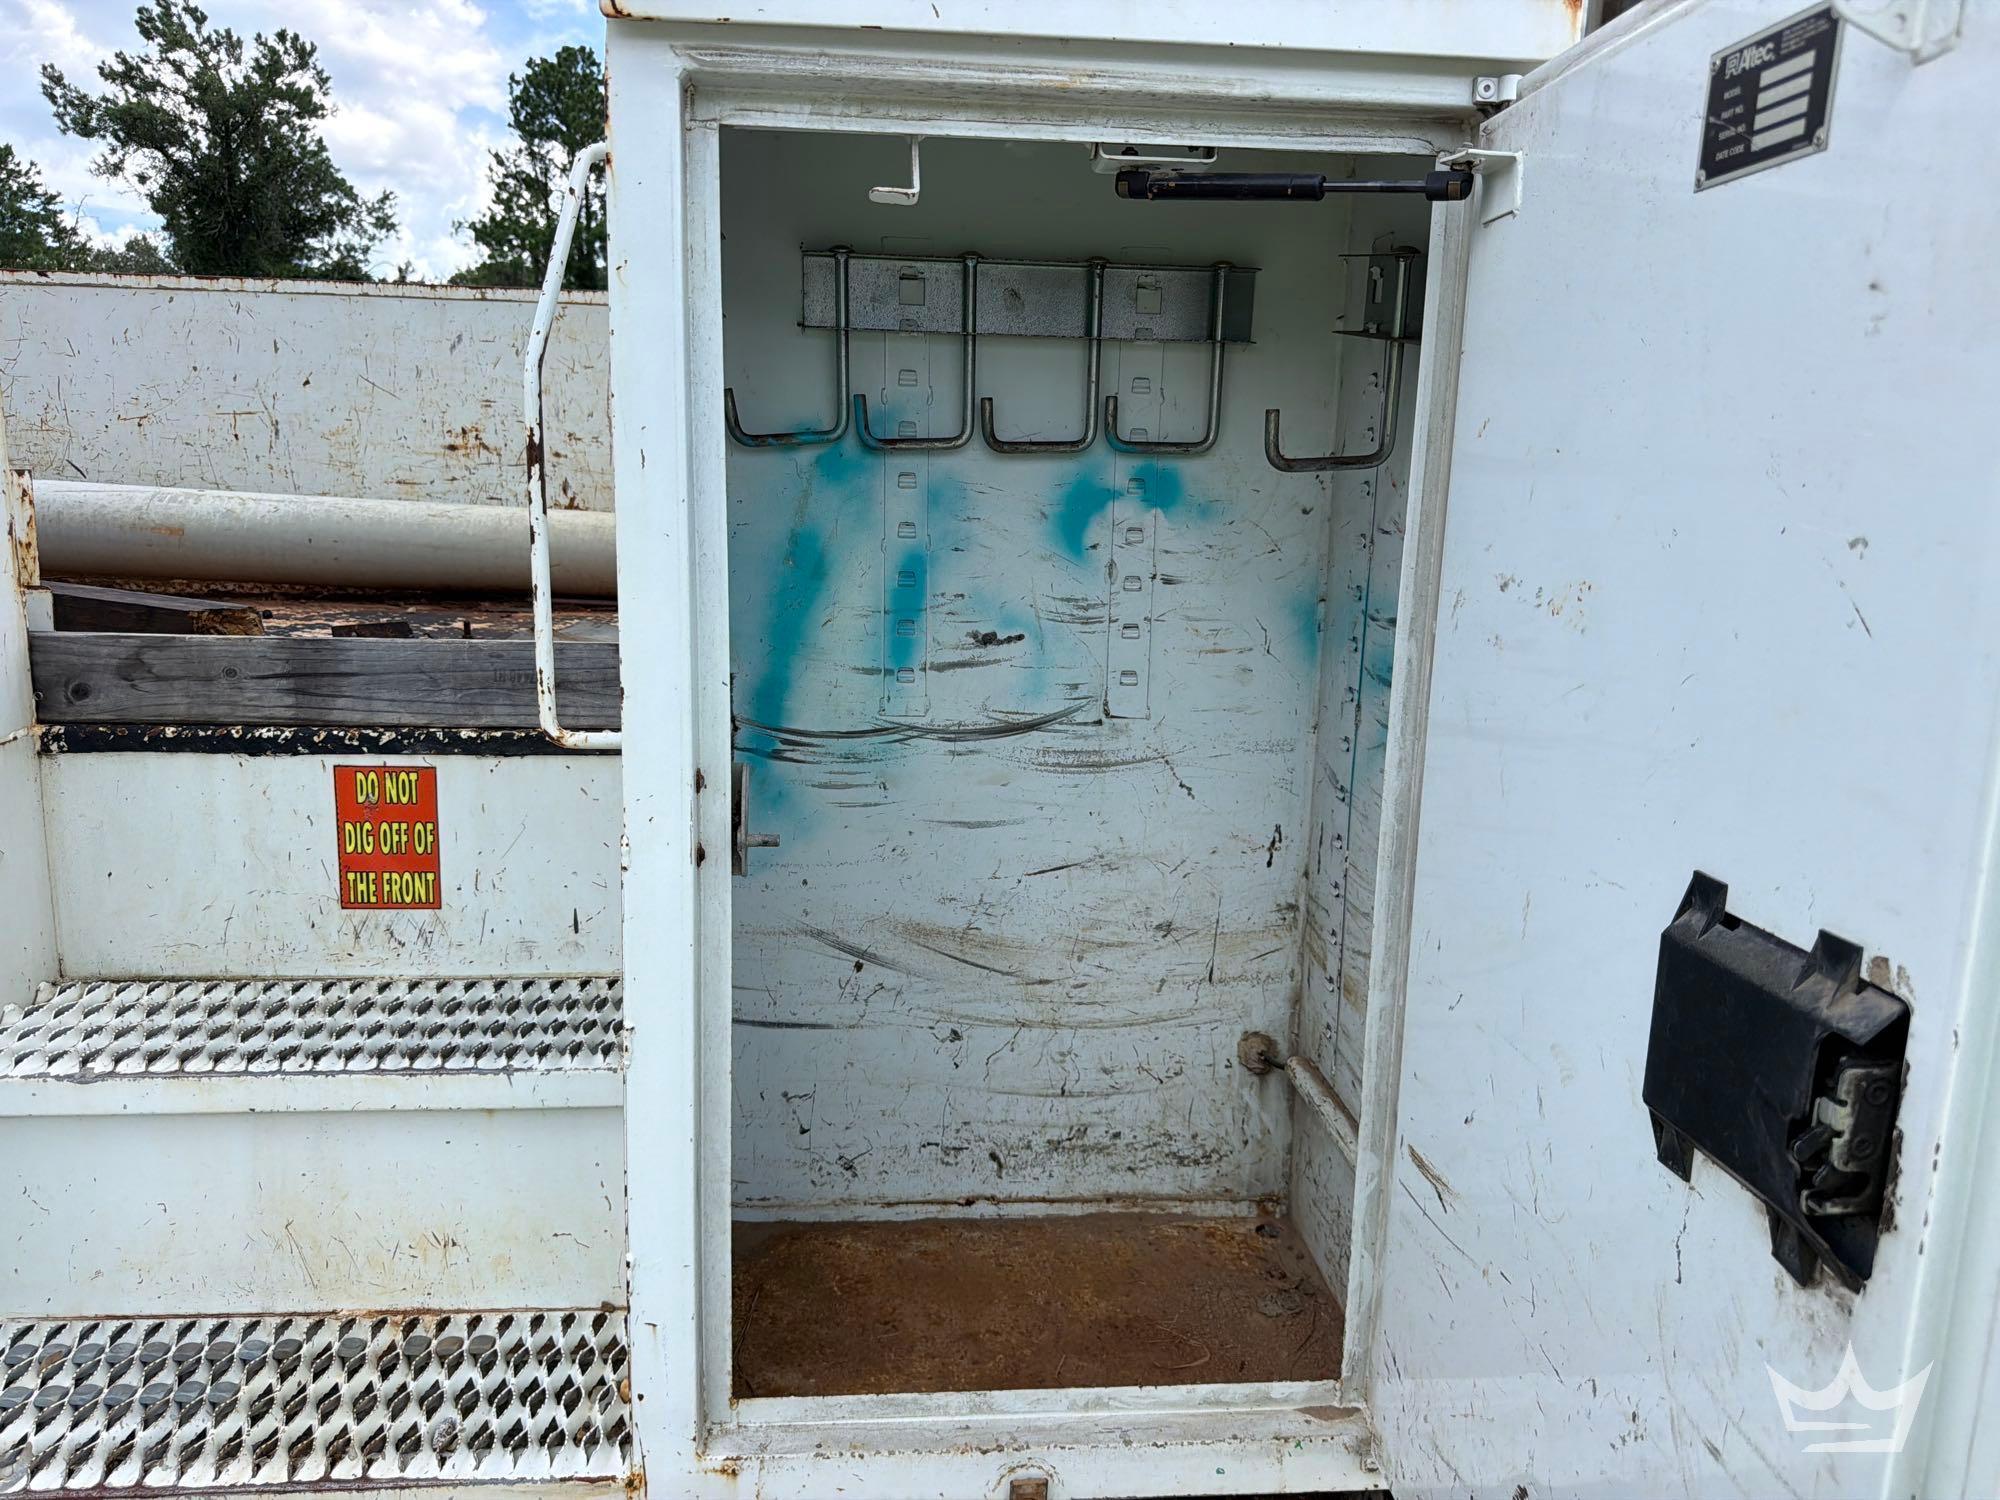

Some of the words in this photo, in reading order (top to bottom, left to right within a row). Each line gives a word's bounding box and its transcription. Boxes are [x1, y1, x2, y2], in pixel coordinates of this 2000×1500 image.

[1740, 42, 1775, 71] Altec
[1716, 150, 1729, 161] DATE
[1729, 144, 1745, 156] CODE
[355, 770, 379, 804] DO
[384, 770, 418, 804] NOT
[344, 821, 375, 854] DIG
[379, 821, 408, 854] OFF
[414, 821, 436, 855] OF
[346, 871, 377, 904] THE
[382, 871, 435, 904] FRONT
